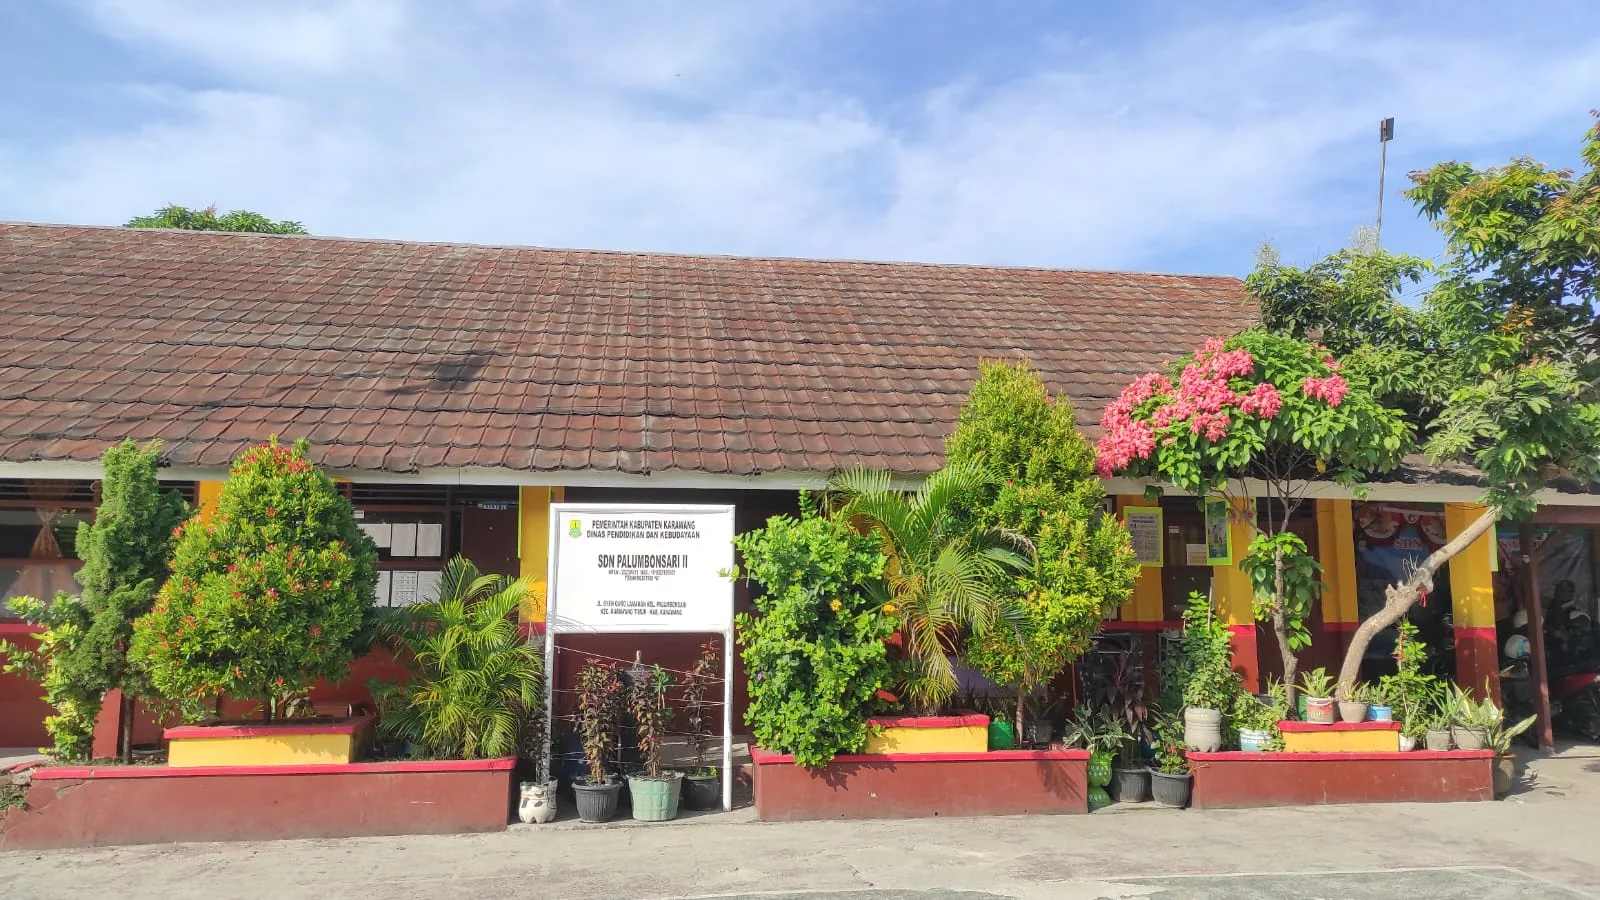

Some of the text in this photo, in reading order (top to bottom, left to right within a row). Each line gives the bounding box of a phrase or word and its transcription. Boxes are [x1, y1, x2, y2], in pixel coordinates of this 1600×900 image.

[592, 520, 696, 530] PEMERINTAH KABUPATEN KARAWANG
[586, 530, 700, 539] DINAS PENDIDIKAN DAN KEBUDAYAAN
[598, 554, 688, 568] SDN PALUMBONSARI II
